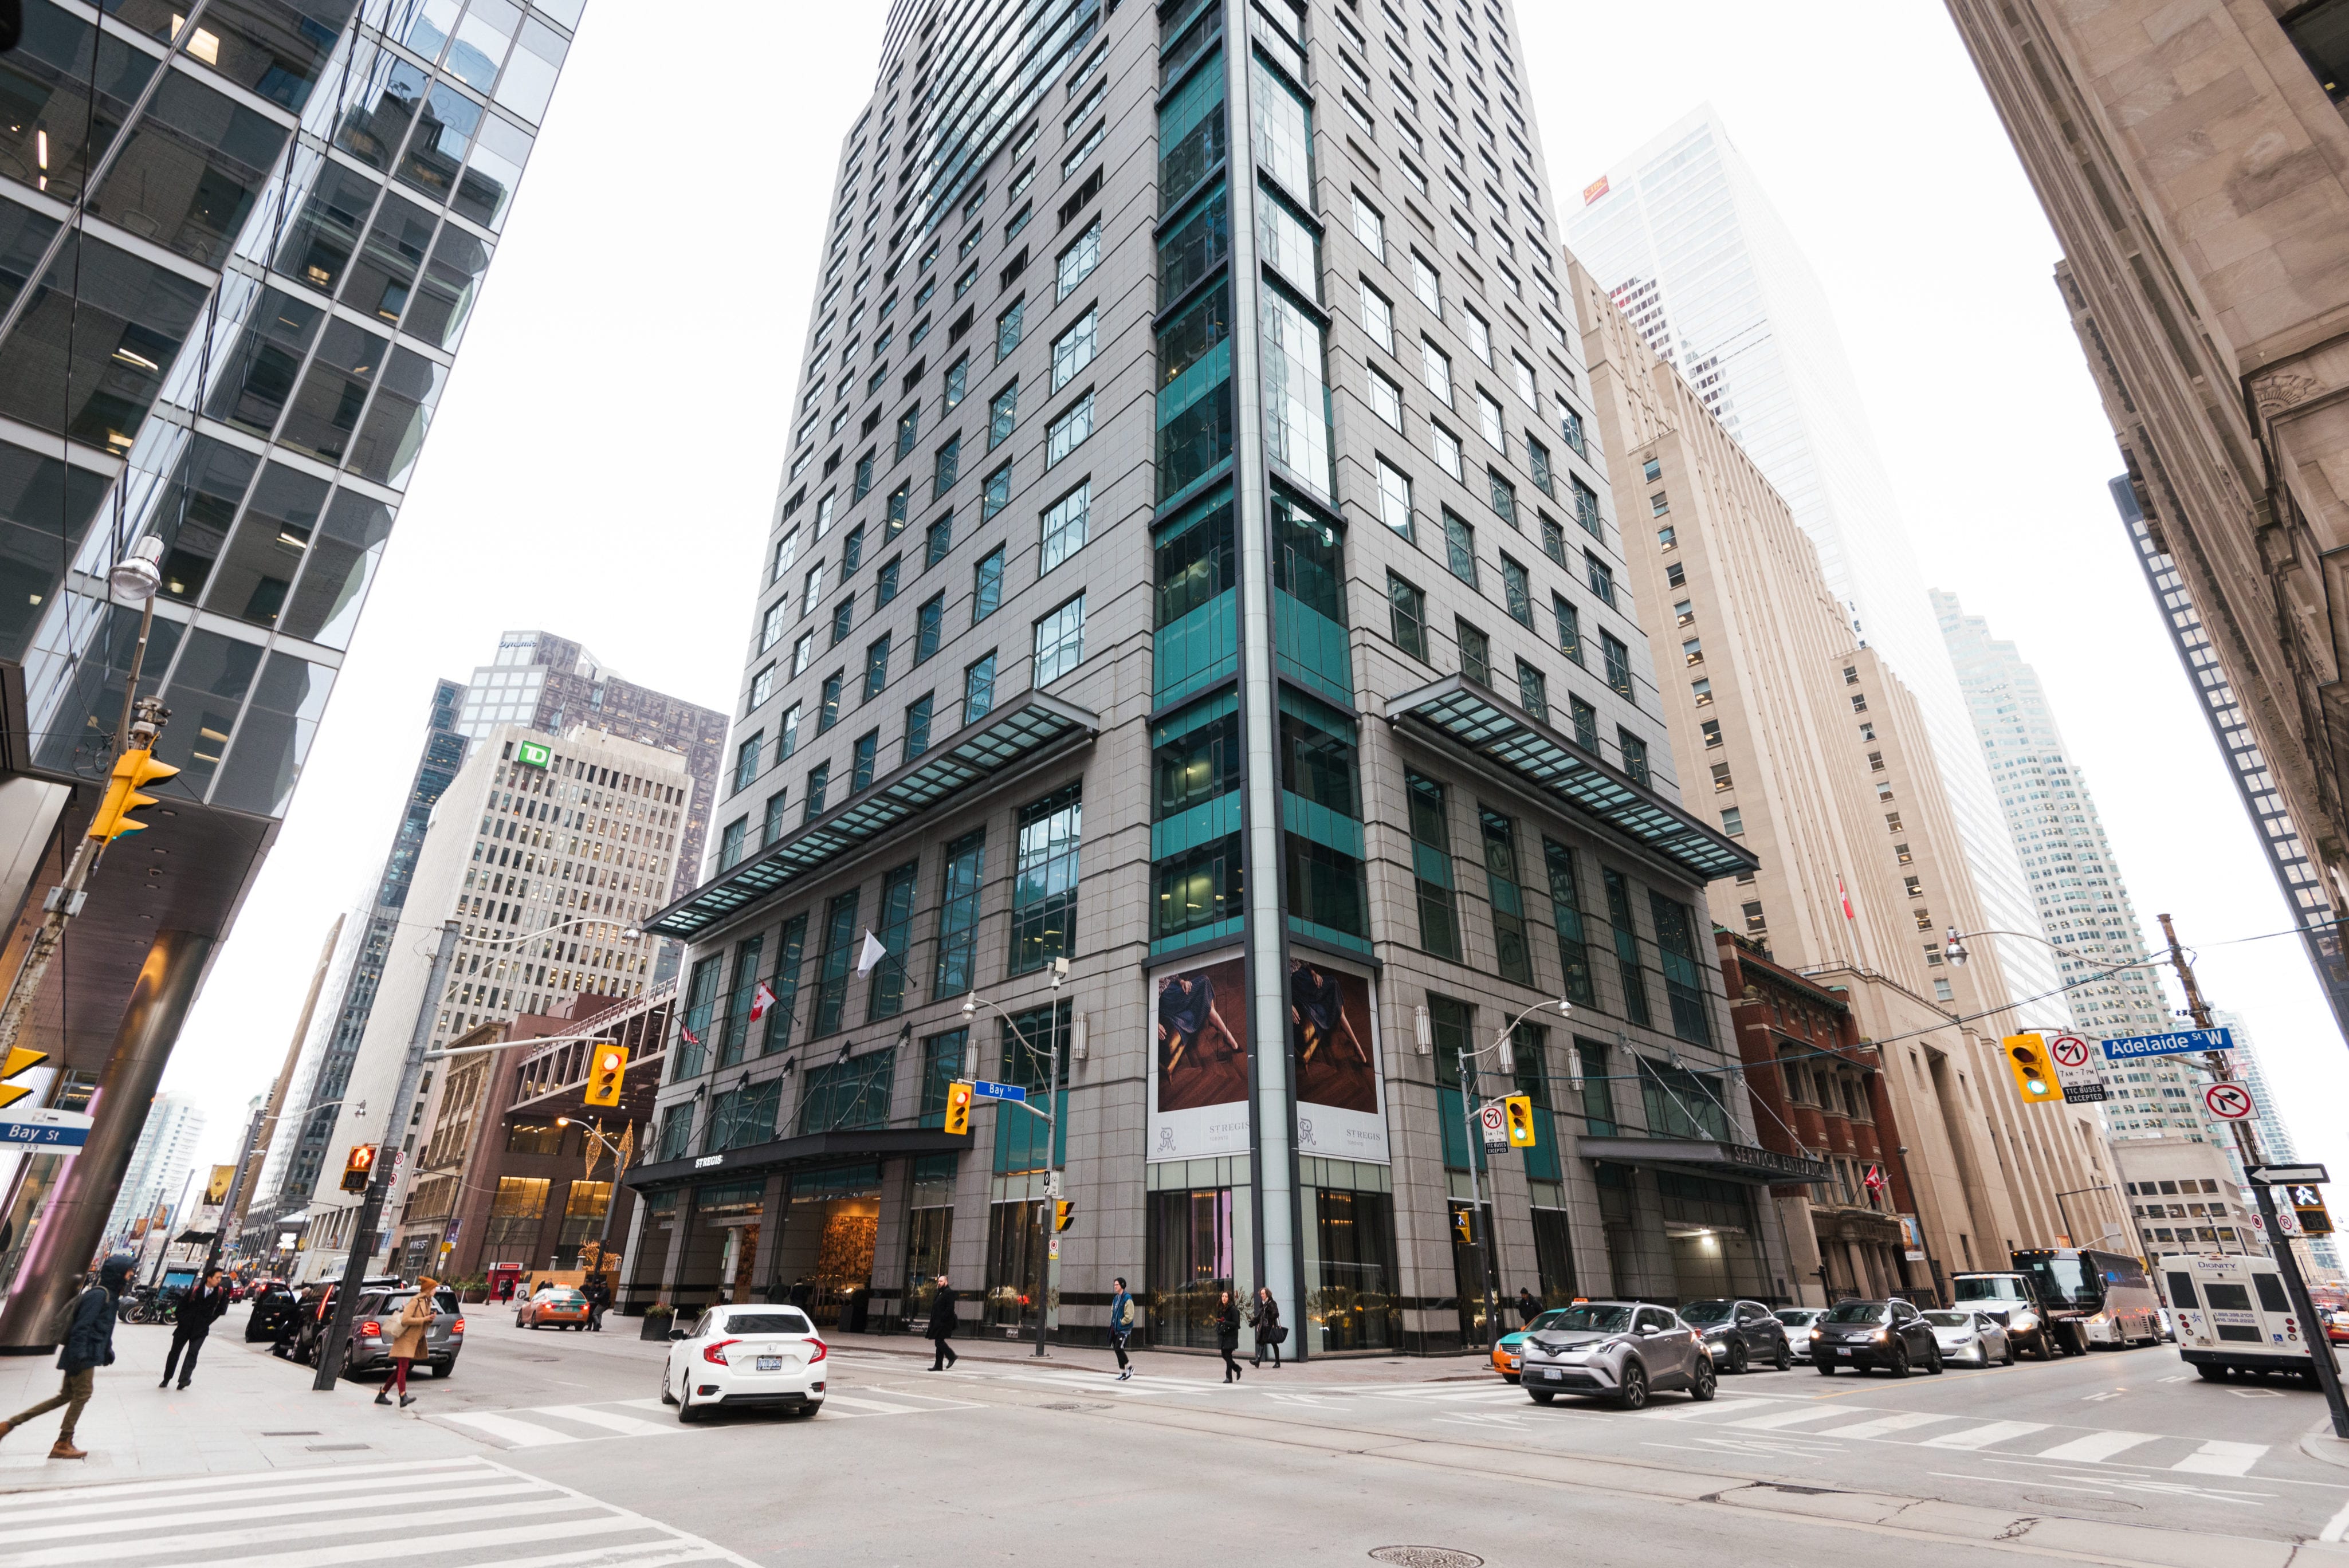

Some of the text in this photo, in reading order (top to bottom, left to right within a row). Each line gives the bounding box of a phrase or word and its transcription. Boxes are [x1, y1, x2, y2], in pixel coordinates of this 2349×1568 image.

[1585, 177, 1606, 196] CIBC
[524, 744, 547, 763] TD
[2112, 1035, 2189, 1055] Adelaide
[2206, 1030, 2222, 1045] W
[989, 1084, 1004, 1097] Bay
[2069, 1094, 2103, 1102] EXCEPTED
[9, 1125, 60, 1142] Bay St
[1222, 1122, 1250, 1132] REGIS
[1357, 1131, 1380, 1141] REGIS
[702, 1154, 724, 1166] REGIS
[1734, 1146, 1828, 1177] SERVICE ENTRANCE
